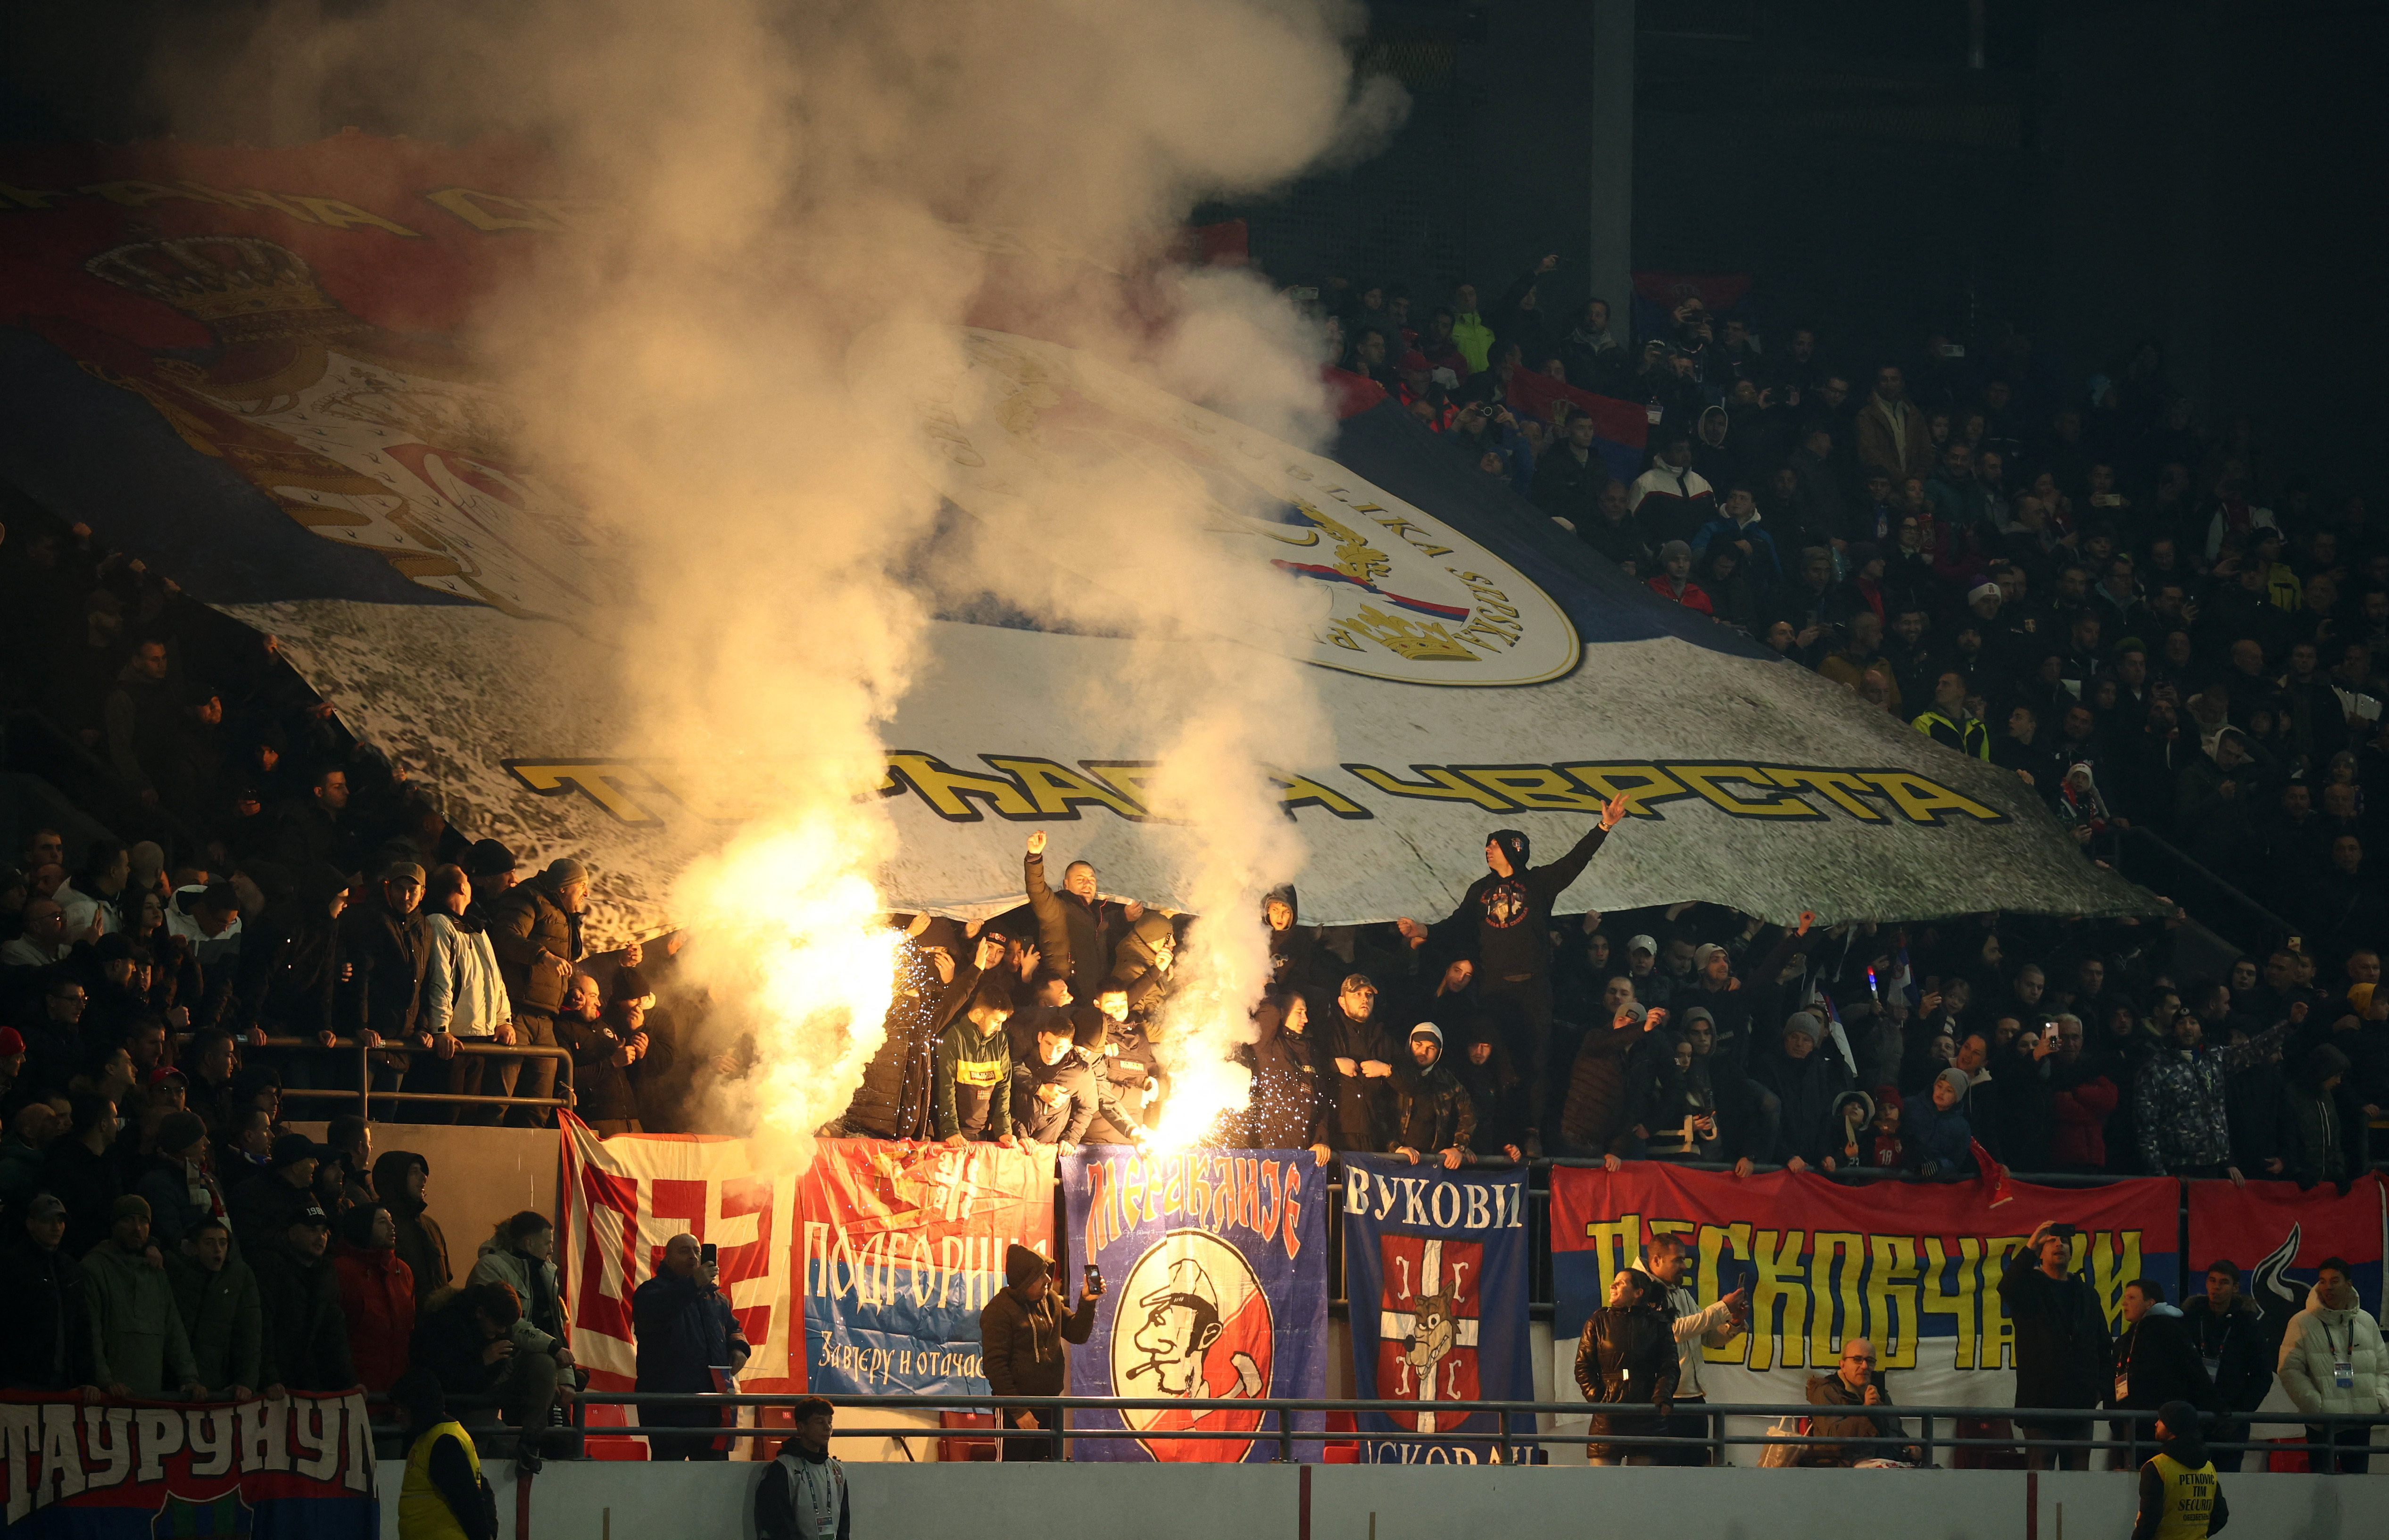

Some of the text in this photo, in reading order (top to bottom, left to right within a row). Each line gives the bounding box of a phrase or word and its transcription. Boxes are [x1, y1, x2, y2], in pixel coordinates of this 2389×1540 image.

[1342, 760, 2013, 827] ЧВРСТА
[1343, 1163, 1522, 1229] ВУКОВИ
[2179, 1471, 2215, 1486] PETKOVIĆ
[2193, 1486, 2207, 1497] TIM
[2178, 1499, 2213, 1511] SECURIT
